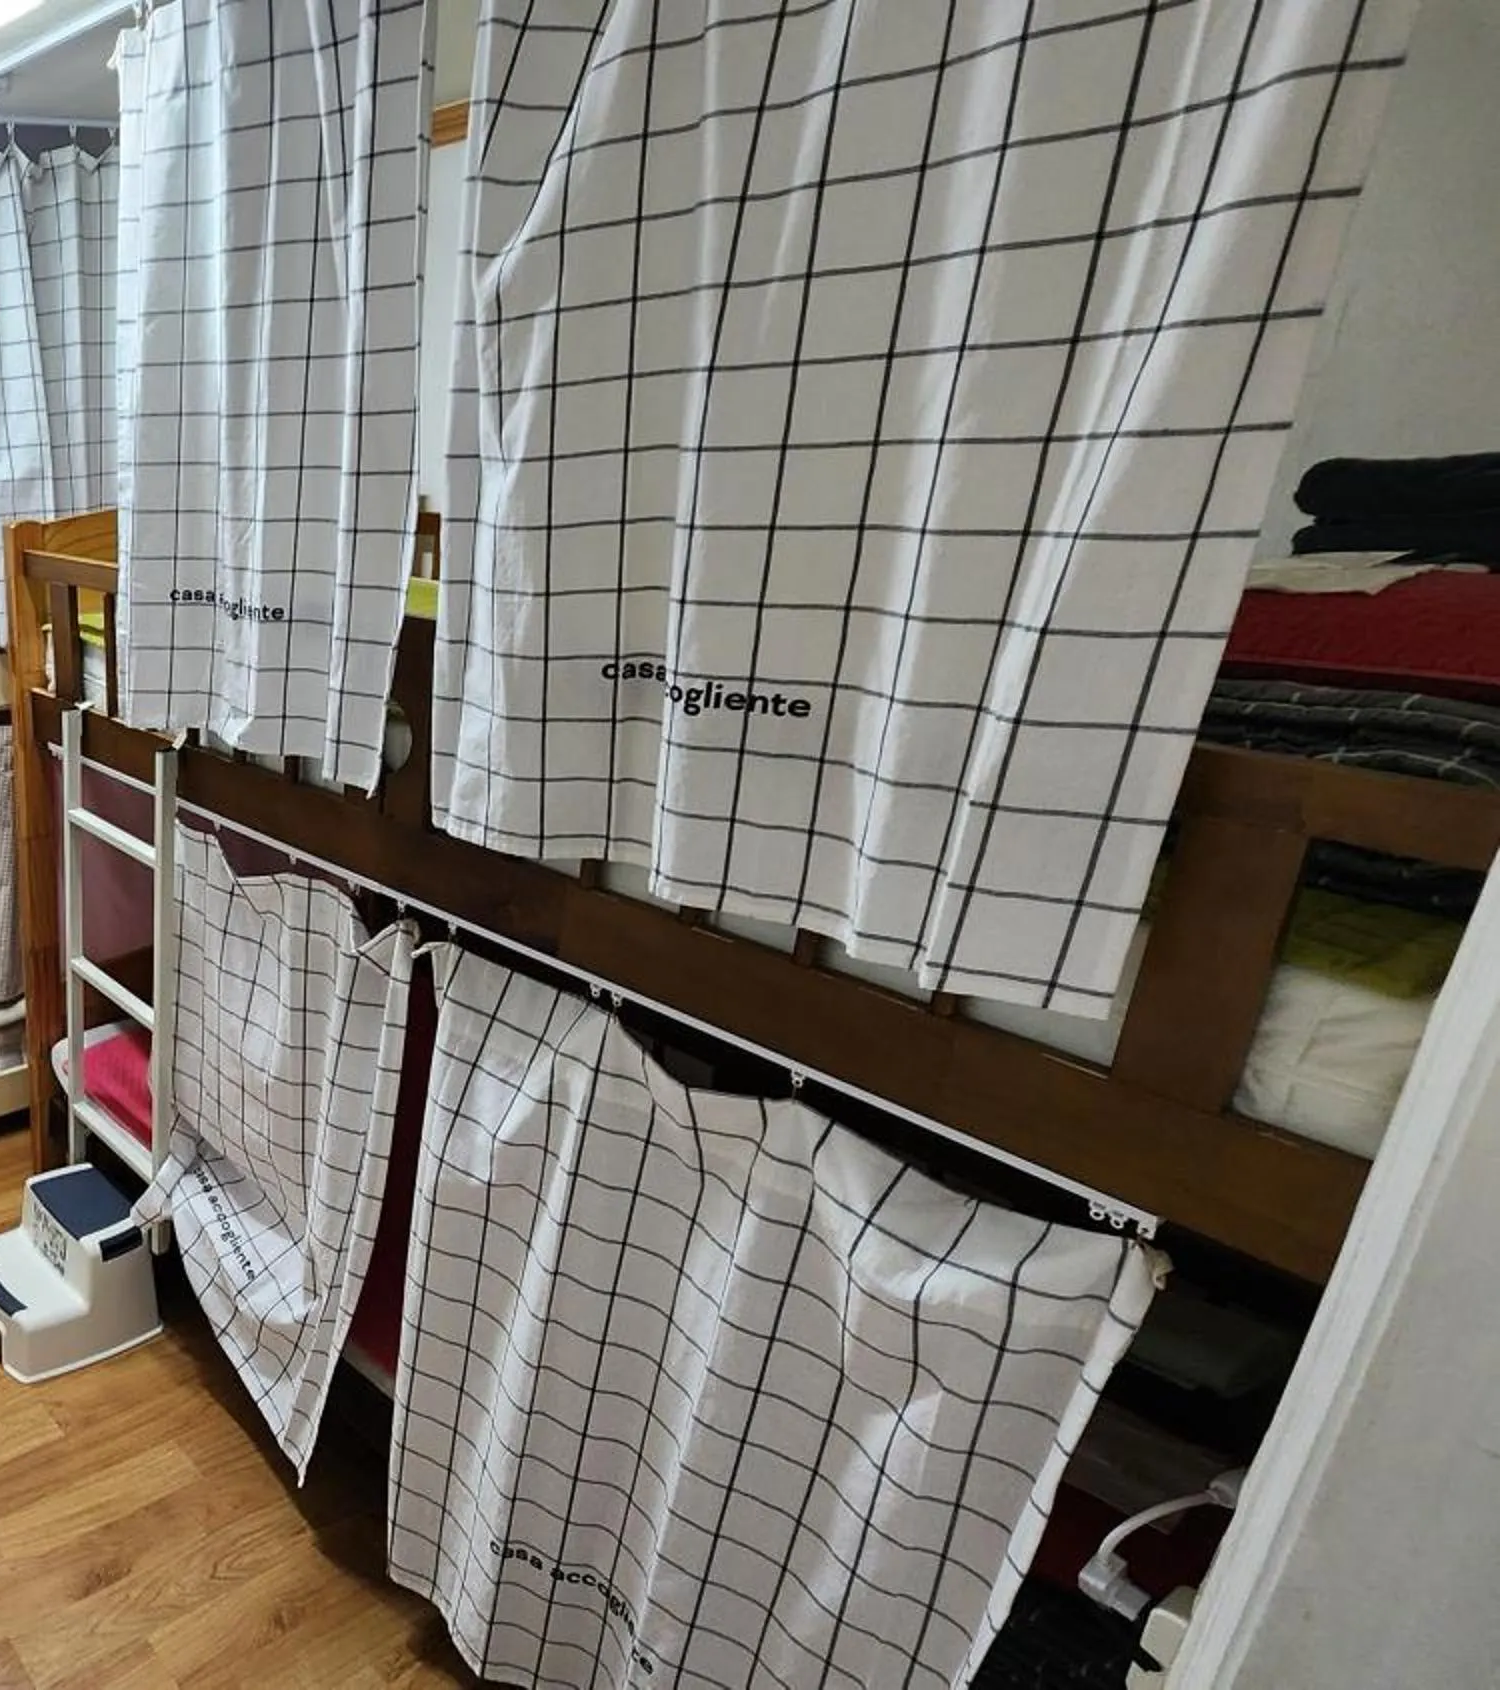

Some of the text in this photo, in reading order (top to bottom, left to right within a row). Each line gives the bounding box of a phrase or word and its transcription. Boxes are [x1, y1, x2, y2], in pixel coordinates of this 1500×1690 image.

[169, 588, 216, 603] casa
[601, 660, 667, 682] casa
[489, 1540, 654, 1675] casa accogliete
